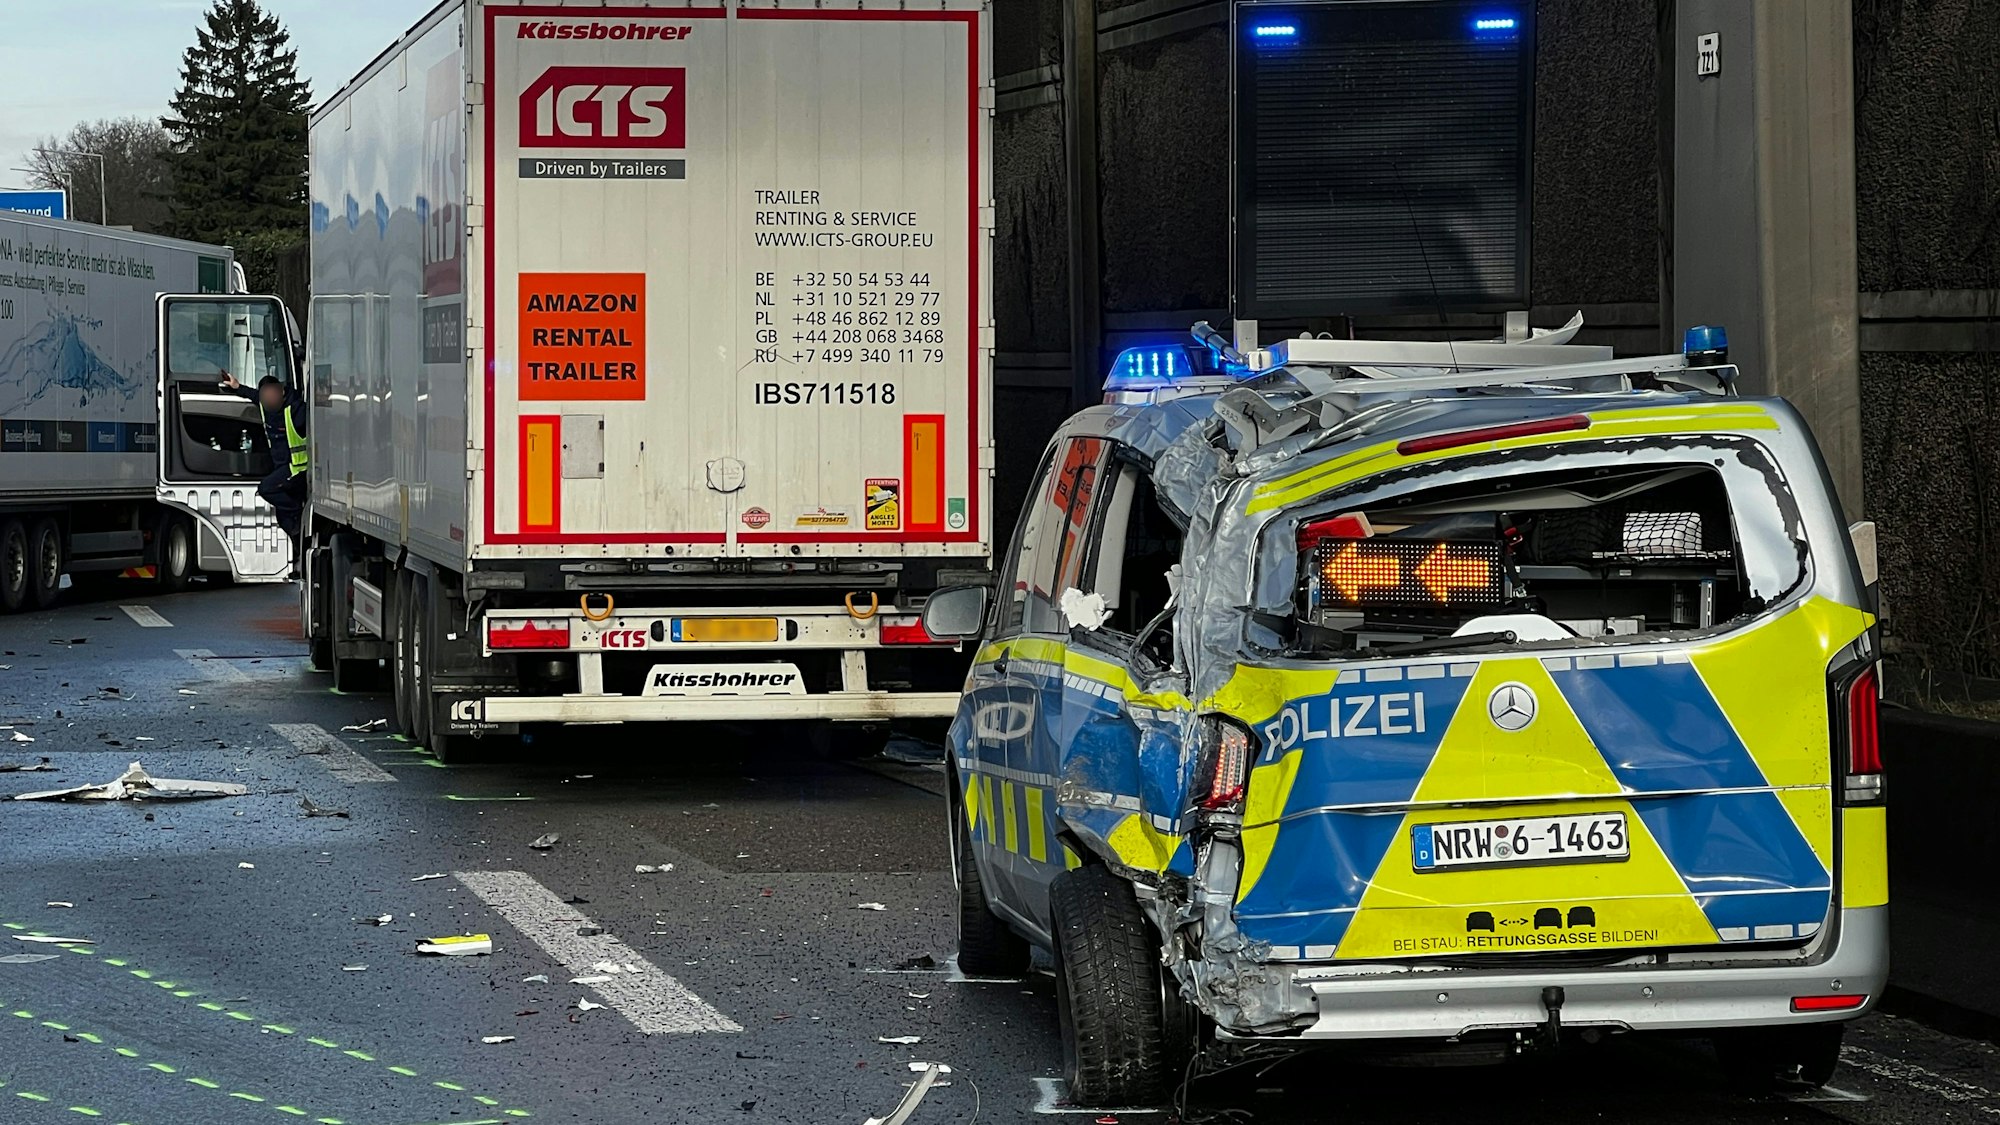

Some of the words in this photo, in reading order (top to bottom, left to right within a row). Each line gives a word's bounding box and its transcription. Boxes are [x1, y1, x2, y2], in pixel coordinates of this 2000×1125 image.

[517, 21, 692, 40] Kässbohrer
[536, 84, 673, 138] ICTS
[535, 161, 585, 176] Driven
[590, 161, 608, 179] by
[612, 162, 667, 176] Trailers
[755, 190, 820, 205] TRAILER
[755, 211, 827, 226] RENTING
[833, 212, 845, 226] &
[851, 212, 917, 226] SERVICE
[754, 232, 934, 247] WWW.ICTS-GROUP.EU
[34, 244, 66, 269] perfekter
[67, 248, 90, 271] Service
[92, 253, 108, 274] mehr
[117, 256, 126, 276] als
[755, 272, 775, 287] BE
[792, 272, 826, 287] +32
[833, 272, 852, 287] 50
[858, 272, 879, 287] 54
[884, 272, 904, 287] 53
[910, 272, 930, 287] 44
[527, 294, 637, 312] AMAZON
[755, 292, 775, 306] NL
[792, 292, 824, 306] +31
[833, 292, 852, 306] 10
[858, 292, 887, 306] 521
[894, 292, 915, 306] 29
[920, 292, 940, 306] 77
[755, 311, 773, 326] PL
[792, 311, 826, 326] +48
[831, 311, 852, 326] 46
[858, 311, 888, 326] 862
[895, 311, 914, 326] 12
[920, 311, 940, 326] 89
[532, 328, 632, 346] RENTAL
[755, 329, 778, 343] GB
[792, 329, 827, 343] +44
[832, 329, 862, 343] 208
[866, 329, 897, 343] 068
[902, 329, 944, 343] 3468
[755, 349, 777, 363] RU
[792, 349, 815, 363] +7
[821, 349, 853, 363] 499
[860, 349, 891, 363] 340
[898, 349, 913, 363] 11
[922, 349, 944, 363] 79
[527, 362, 637, 381] TRAILER
[755, 383, 896, 405] IBS711518
[601, 630, 647, 648] ICTS
[653, 672, 796, 687] Kässbohrer
[1264, 692, 1426, 762] POLIZEI
[1420, 850, 1428, 860] D
[1433, 827, 1492, 861] NRW
[1512, 819, 1624, 855] 6-1463
[1393, 939, 1417, 951] BEI
[1421, 937, 1463, 949] STAU:
[1466, 932, 1597, 947] RETTUNGSGASSE
[1601, 930, 1659, 943] BILDEN!
